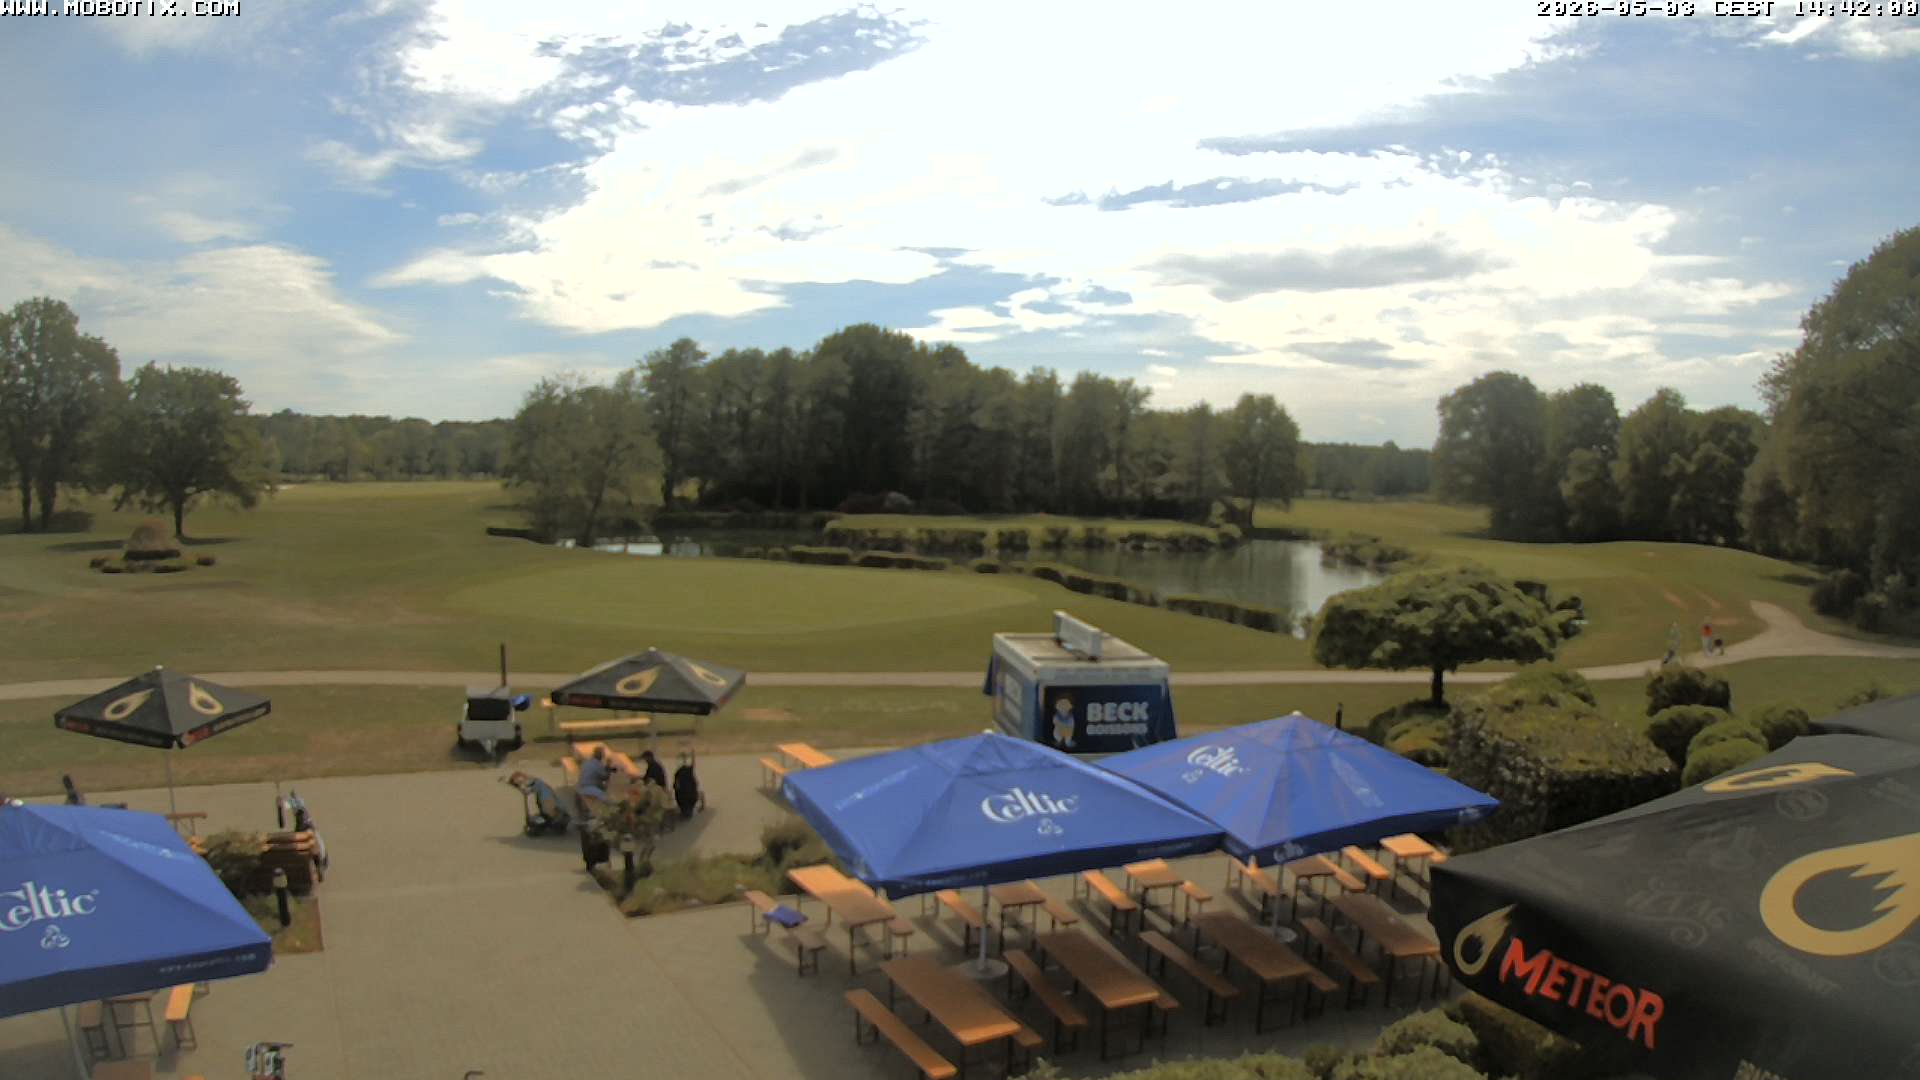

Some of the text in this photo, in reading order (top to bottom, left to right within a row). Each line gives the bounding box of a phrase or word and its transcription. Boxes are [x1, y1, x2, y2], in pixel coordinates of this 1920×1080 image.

[1086, 702, 1150, 722] BECK
[1187, 745, 1243, 776] Celtic
[981, 787, 1077, 822] Celtic
[1498, 937, 1665, 1049] METEOR
